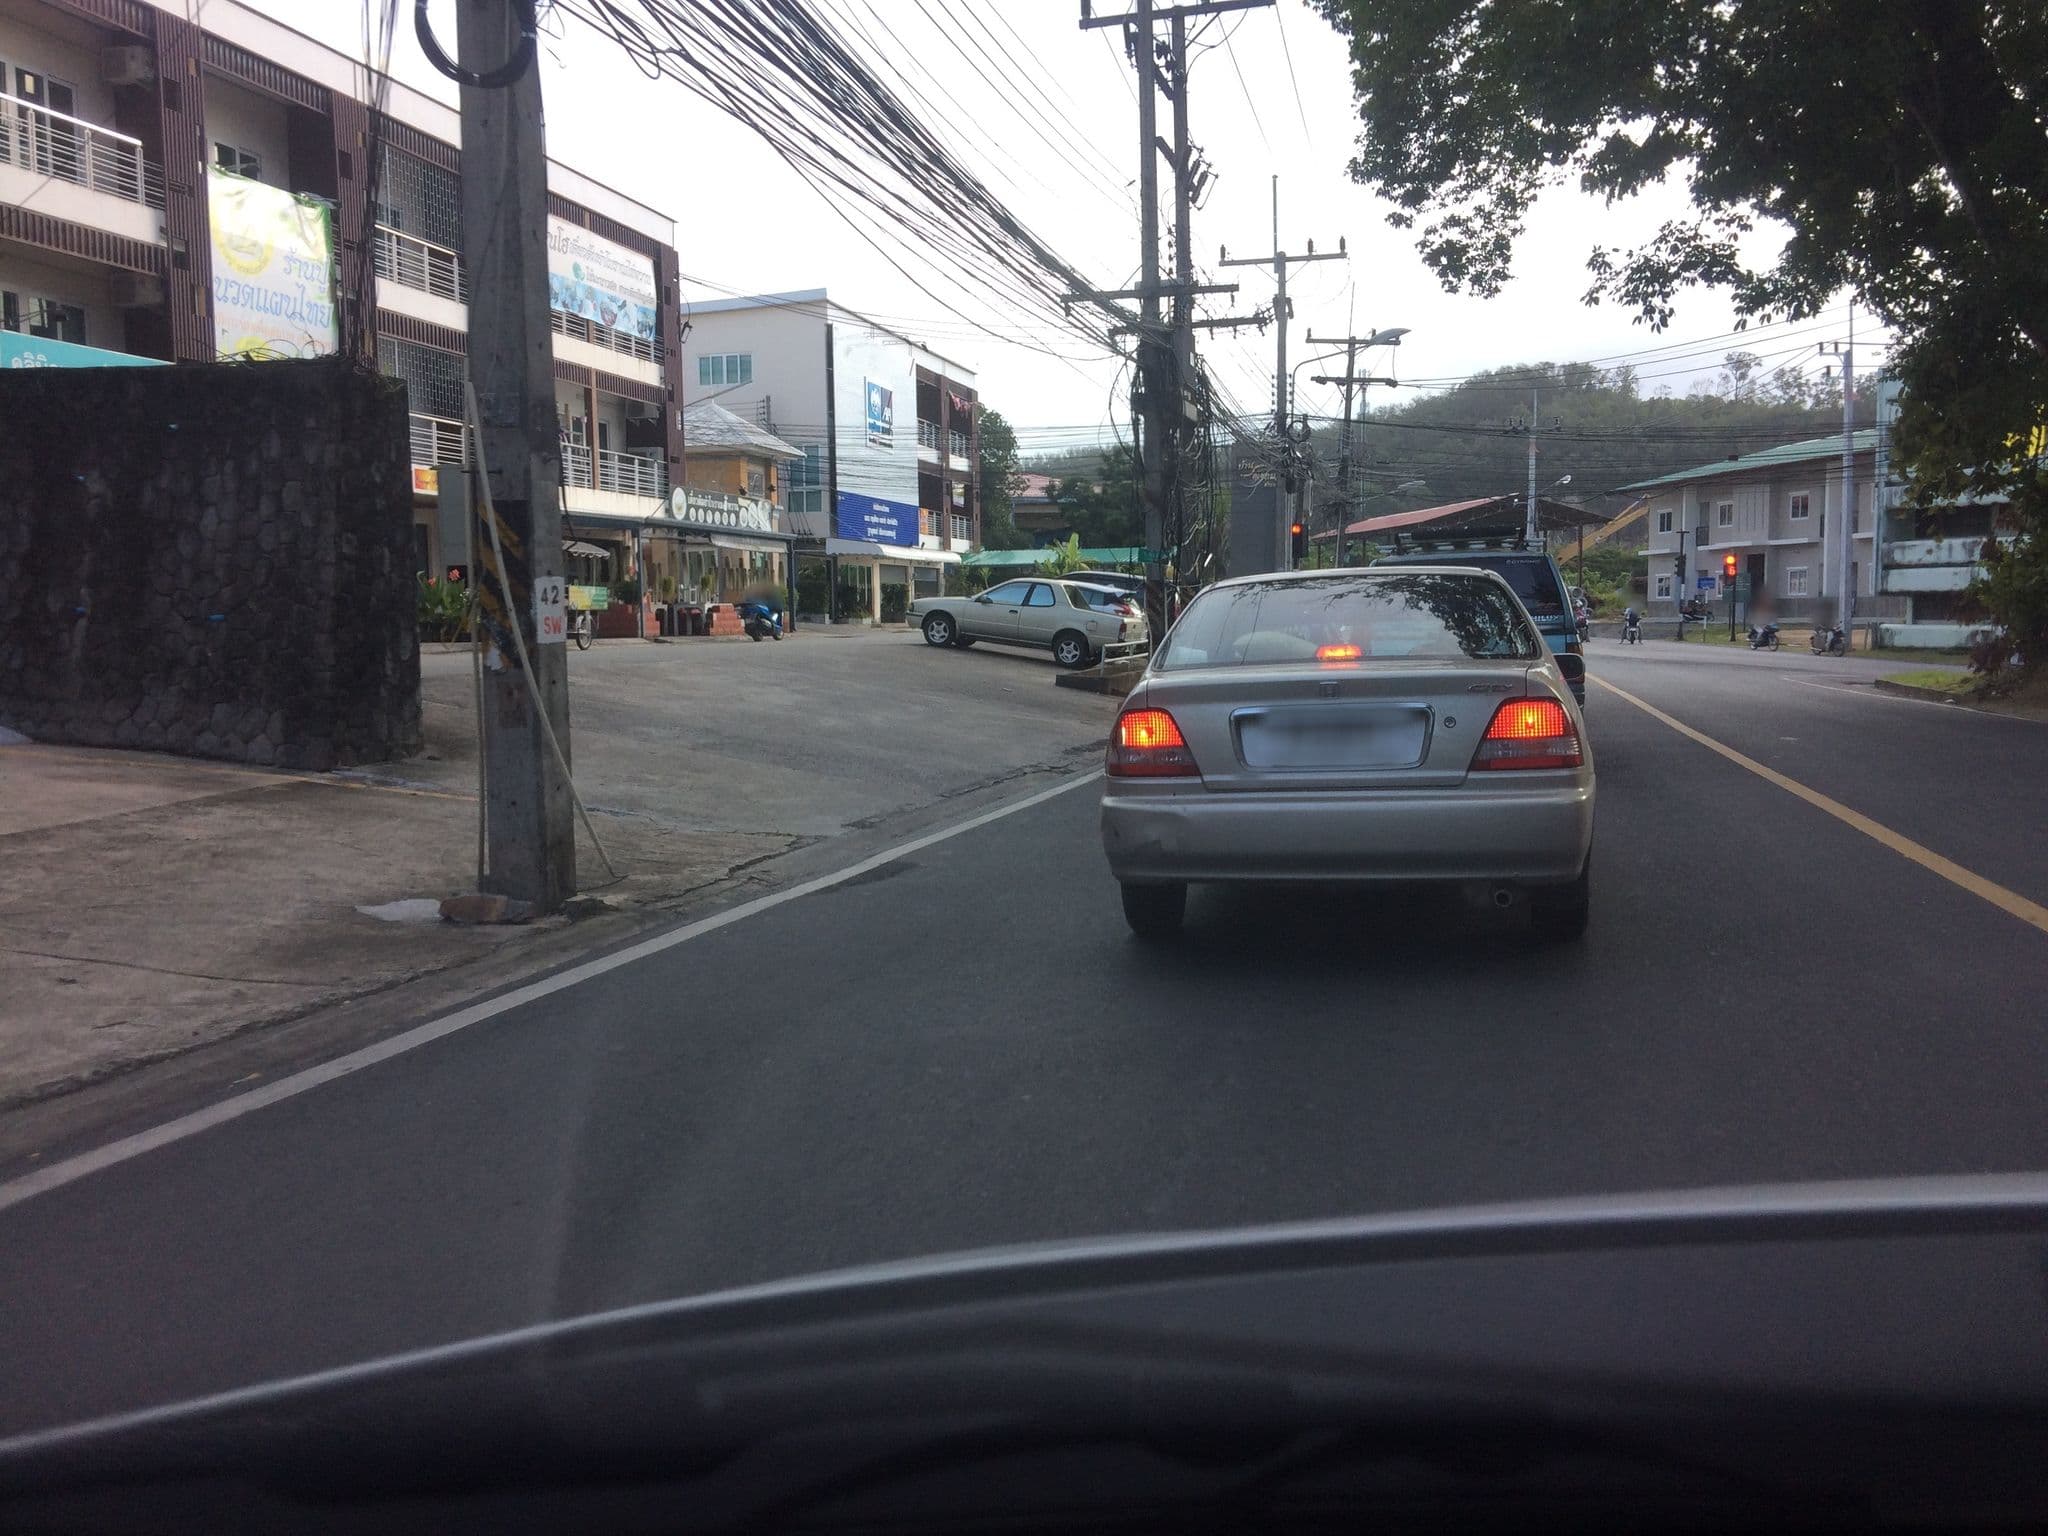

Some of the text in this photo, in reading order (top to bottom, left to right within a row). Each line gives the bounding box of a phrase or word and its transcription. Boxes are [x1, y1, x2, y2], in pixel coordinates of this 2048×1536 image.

[215, 276, 332, 328] นวดแผนไทย
[541, 585, 559, 605] 42
[544, 615, 562, 635] SW
